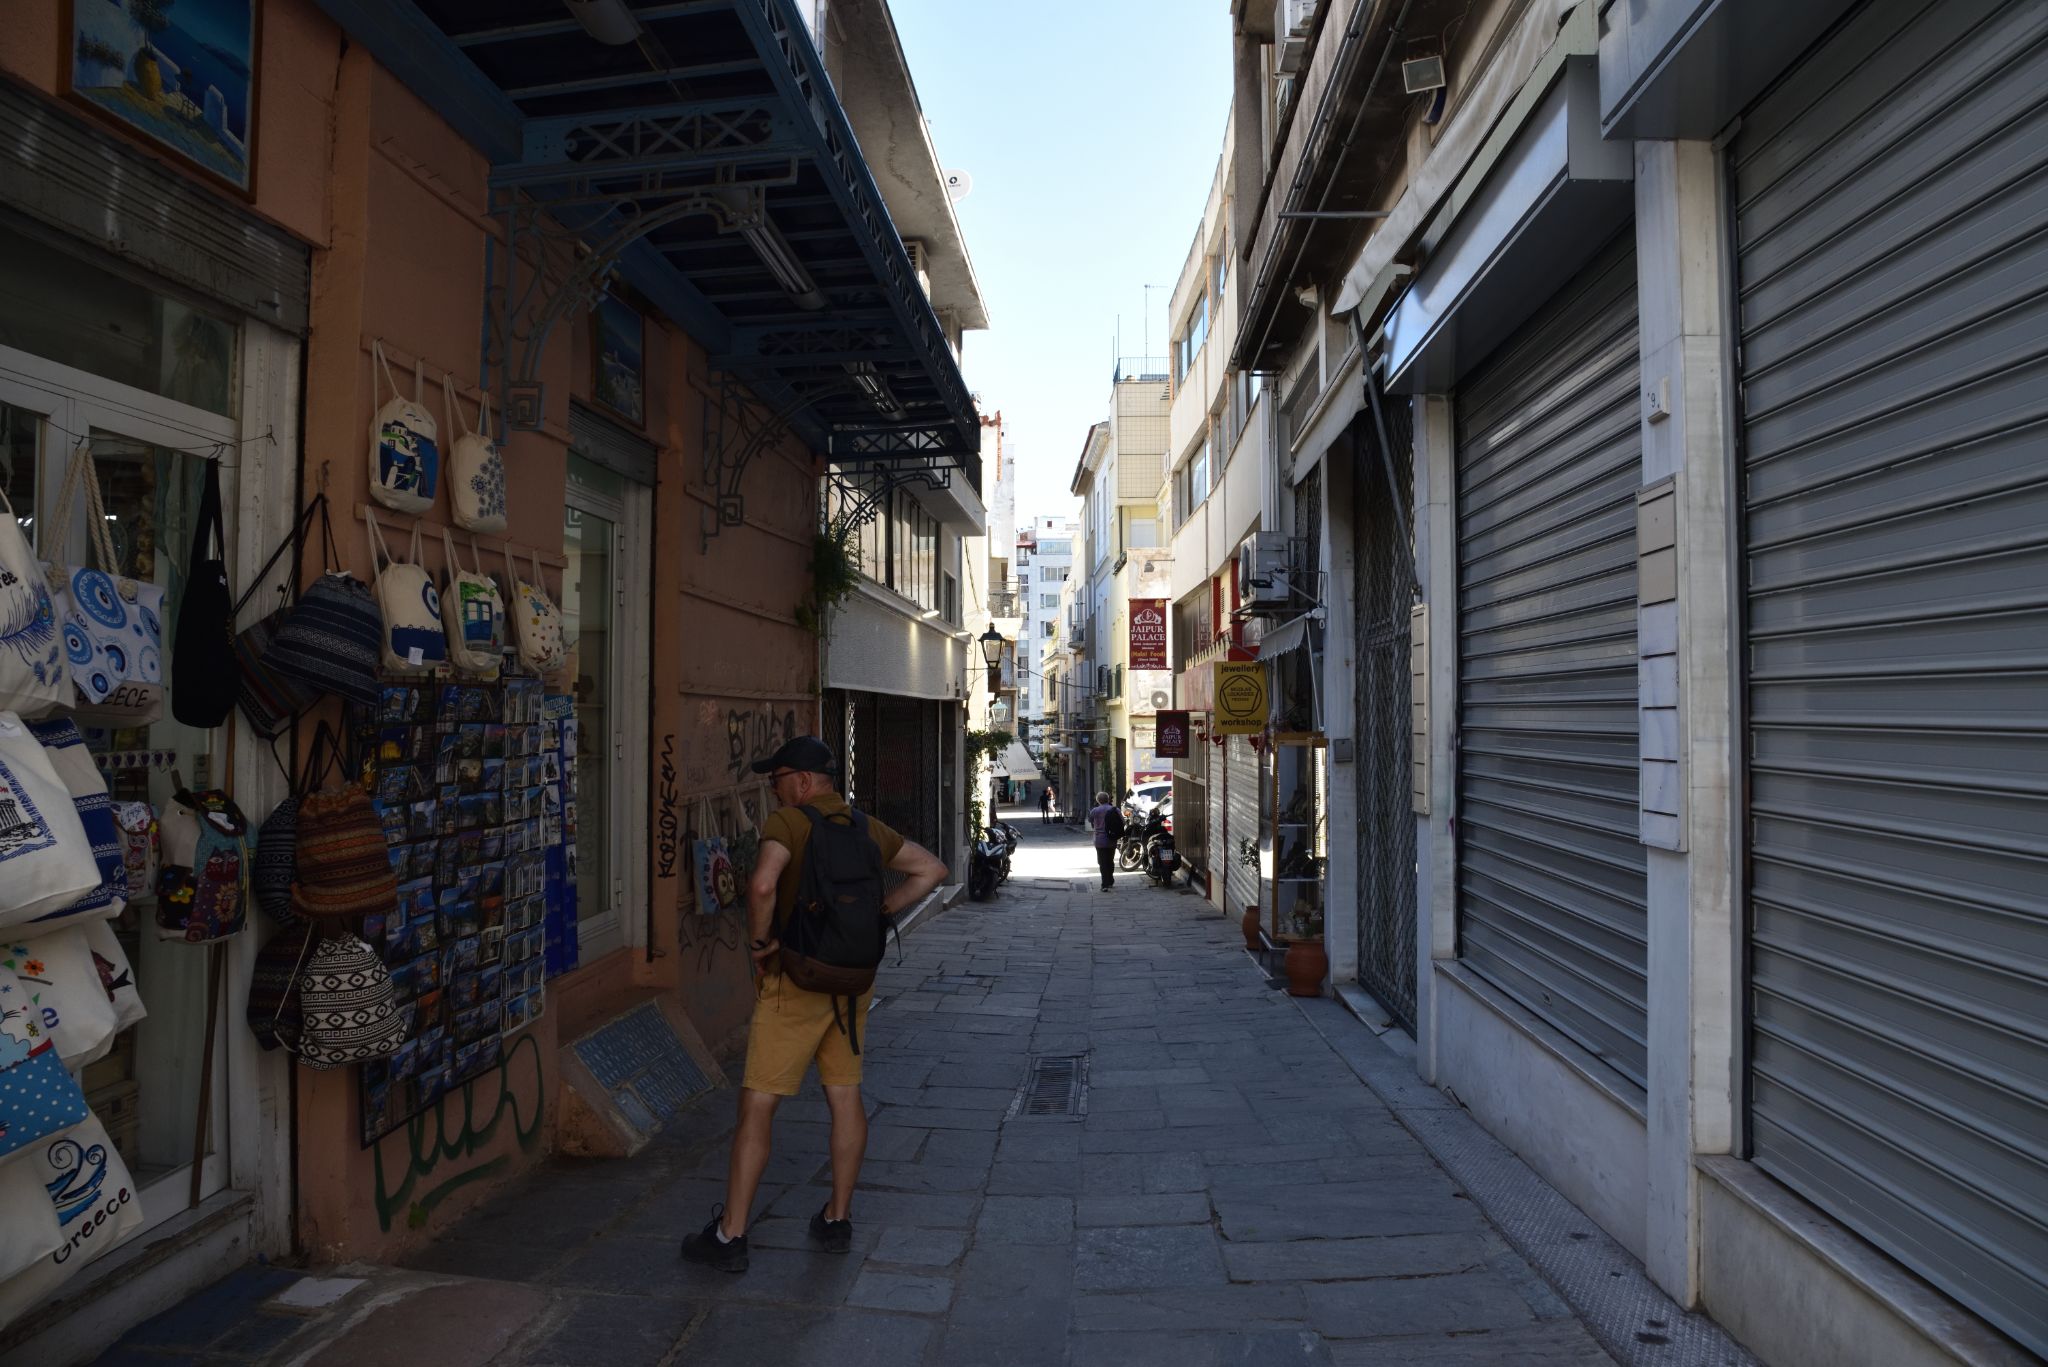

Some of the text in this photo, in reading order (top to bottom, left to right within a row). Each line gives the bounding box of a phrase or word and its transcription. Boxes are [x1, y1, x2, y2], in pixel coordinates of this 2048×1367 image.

[1131, 625, 1164, 633] JAIPUR
[1131, 633, 1165, 641] PALACE
[1221, 664, 1260, 674] jewellery
[1221, 718, 1262, 727] workshop
[53, 1187, 131, 1264] Greece
